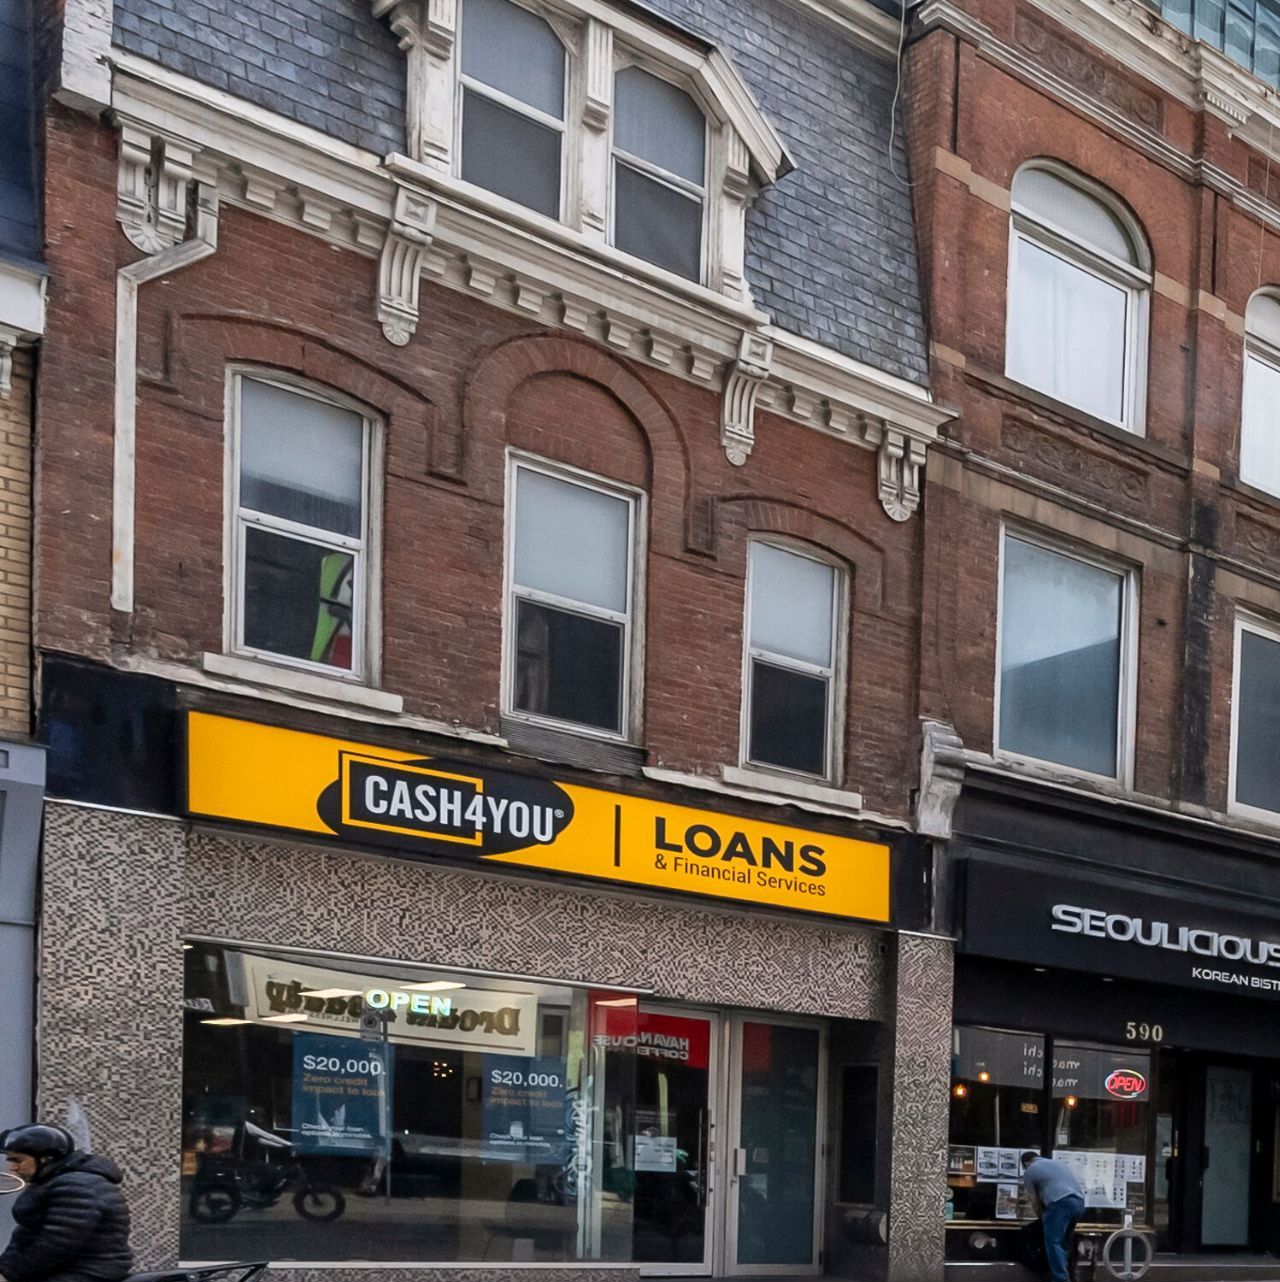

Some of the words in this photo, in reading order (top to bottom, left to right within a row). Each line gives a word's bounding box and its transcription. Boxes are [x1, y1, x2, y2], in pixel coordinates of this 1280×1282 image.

[654, 815, 827, 878] LOANS
[654, 853, 668, 871] &
[673, 856, 752, 885] Financial
[756, 871, 827, 897] Services
[1191, 966, 1249, 986] KOREAN
[365, 988, 452, 1017] OPEN
[1125, 1022, 1163, 1042] 590
[1108, 1074, 1146, 1093] OPEN
